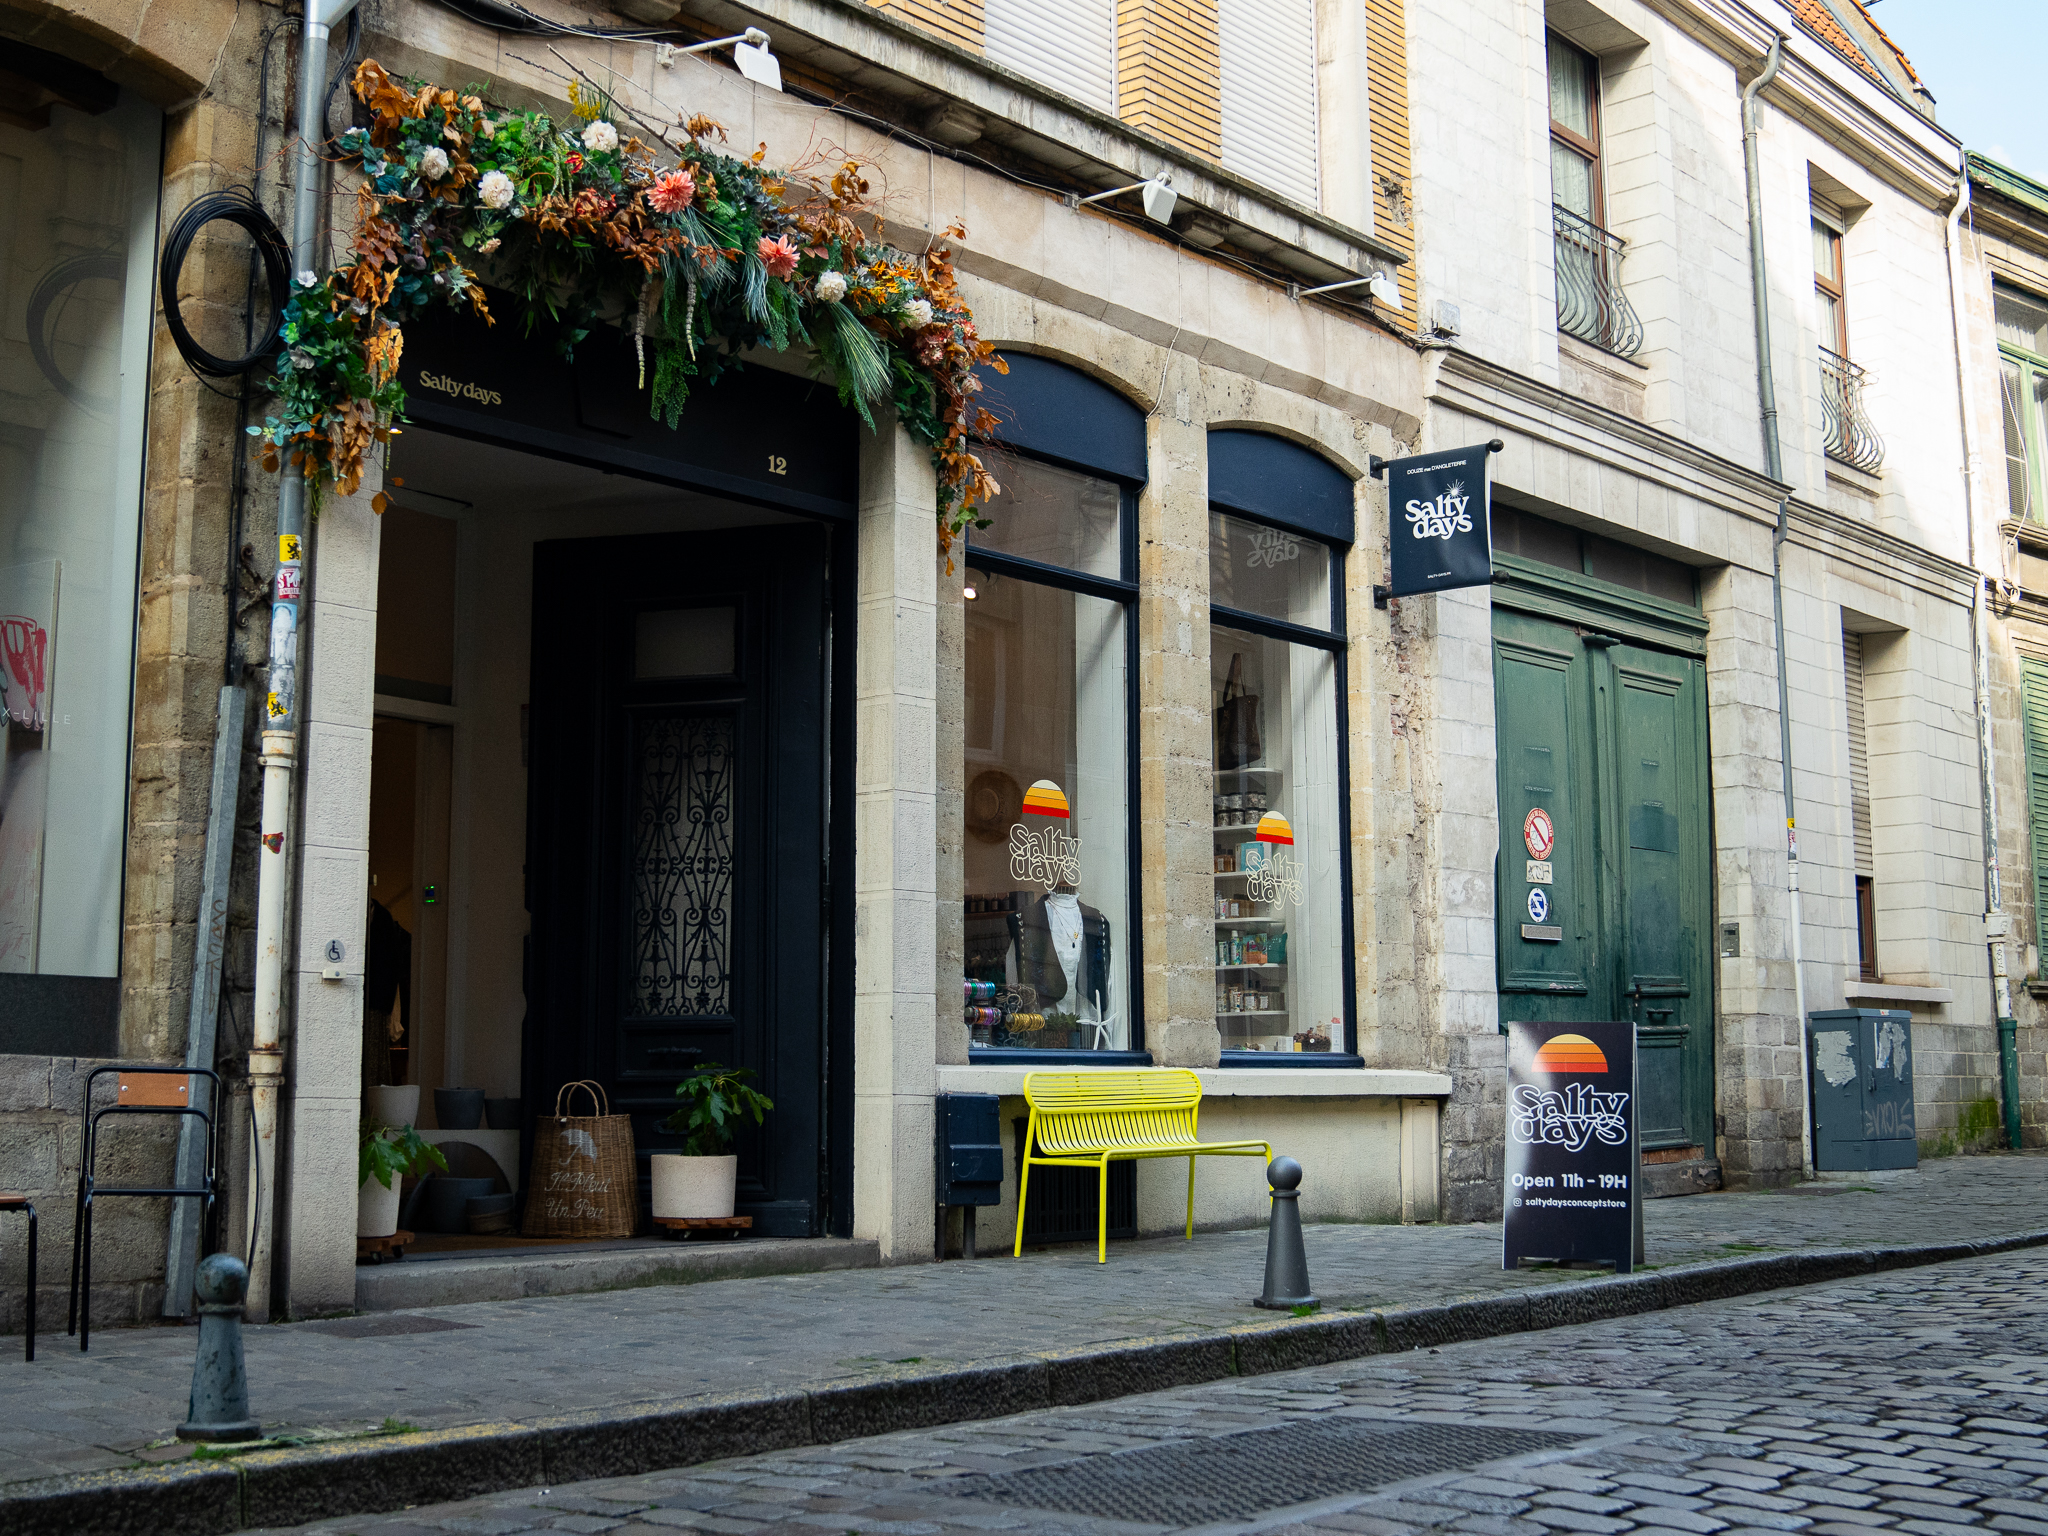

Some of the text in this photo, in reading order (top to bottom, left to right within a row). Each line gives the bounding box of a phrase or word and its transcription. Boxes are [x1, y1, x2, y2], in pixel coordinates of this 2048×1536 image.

[420, 370, 502, 405] Salty days
[768, 455, 787, 475] 12
[1405, 494, 1470, 522] Salty
[1412, 514, 1473, 540] days
[1009, 823, 1083, 870] Salty
[1010, 848, 1082, 890] days
[1246, 851, 1304, 889] Salty
[1246, 873, 1304, 910] days
[1510, 1082, 1629, 1123] Salty
[1511, 1106, 1628, 1152] days
[566, 1171, 611, 1192] Pleut
[1511, 1173, 1554, 1190] Open
[1561, 1173, 1584, 1188] 11h
[1598, 1174, 1627, 1189] 19H
[546, 1198, 604, 1219] Un Peu
[1525, 1197, 1627, 1209] saltydaysconceptstore
